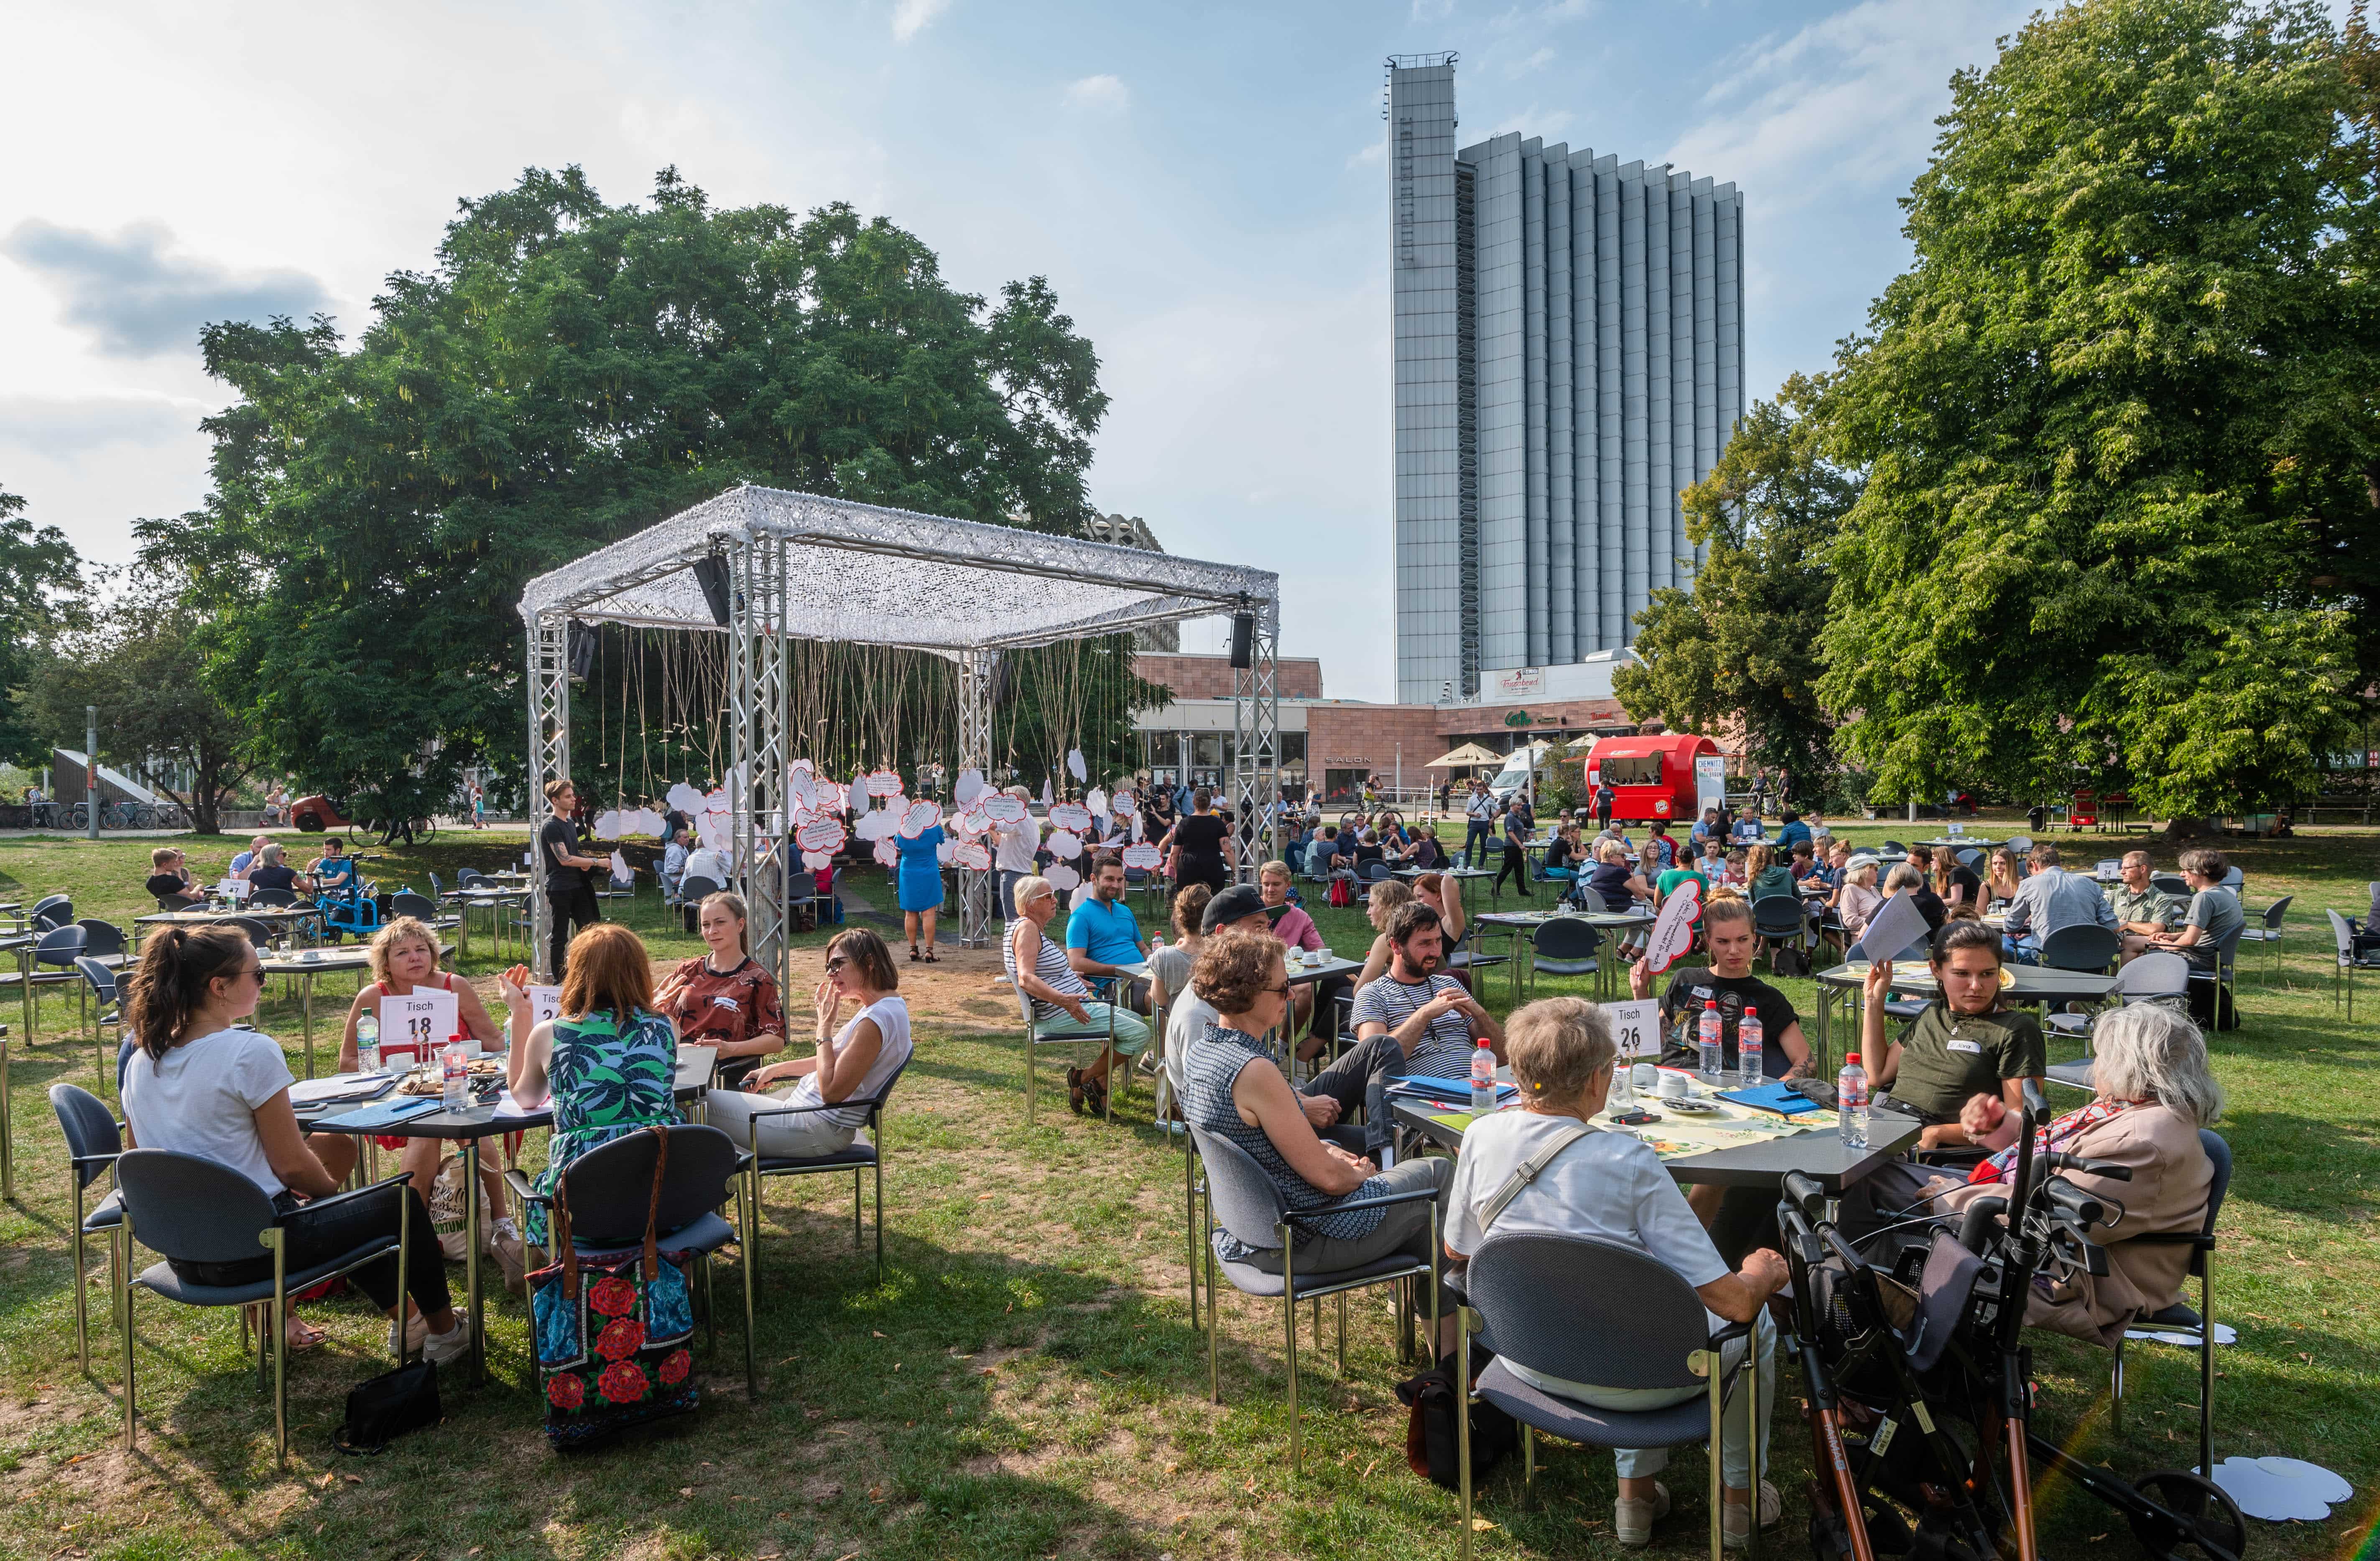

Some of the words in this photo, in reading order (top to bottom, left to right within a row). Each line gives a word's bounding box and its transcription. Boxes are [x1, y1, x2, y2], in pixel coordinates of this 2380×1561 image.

[1501, 677, 1538, 688] Tanzabend
[1672, 899, 1688, 922] Chemnitz
[543, 994, 561, 1003] Tisc
[406, 1001, 433, 1011] Tisch
[543, 1009, 561, 1020] 2
[1619, 1008, 1640, 1020] Tisch
[408, 1017, 431, 1034] 18
[1621, 1026, 1640, 1047] 26
[434, 1218, 468, 1235] ORTUN
